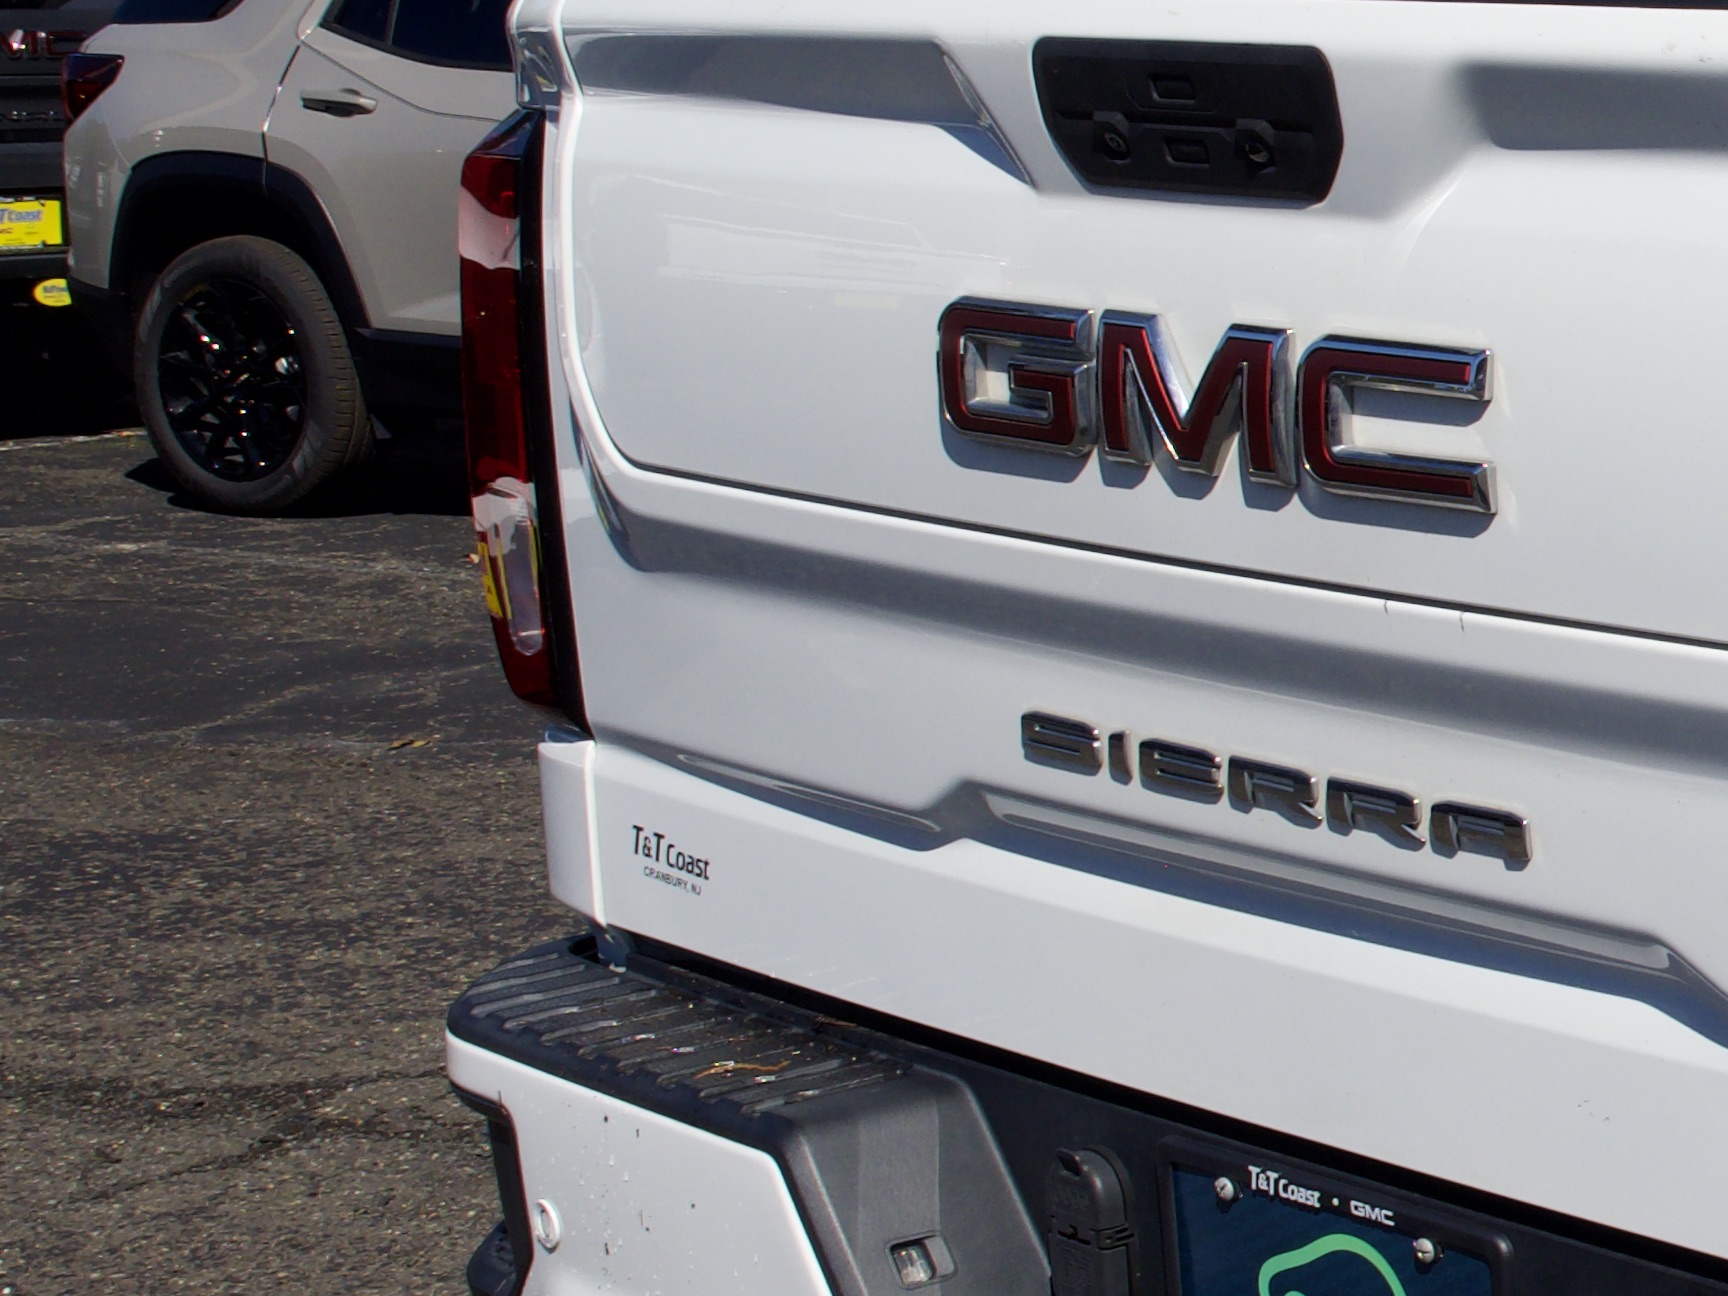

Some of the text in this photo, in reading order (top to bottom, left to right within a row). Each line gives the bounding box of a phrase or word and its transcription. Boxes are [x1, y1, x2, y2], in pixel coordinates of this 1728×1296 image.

[938, 296, 1498, 515] GMC
[1021, 711, 1534, 869] SIERRA
[632, 824, 711, 881] T&T Coast
[1247, 1164, 1395, 1227] T&T Coast GMC
